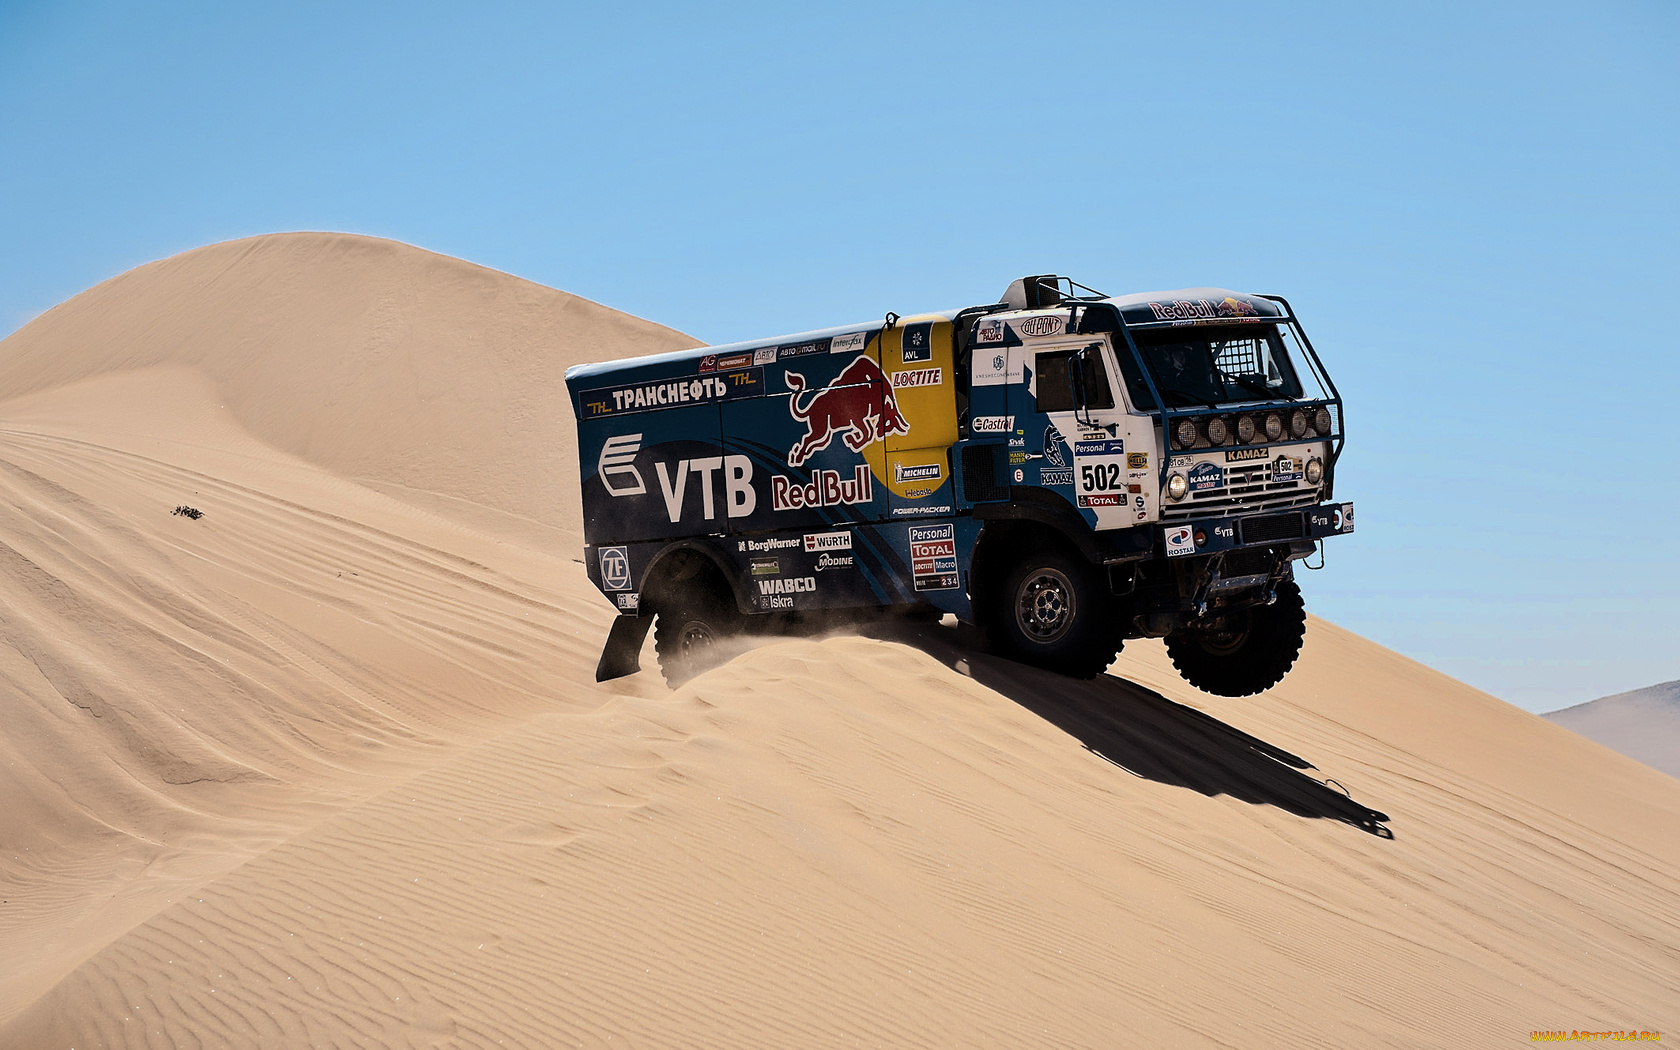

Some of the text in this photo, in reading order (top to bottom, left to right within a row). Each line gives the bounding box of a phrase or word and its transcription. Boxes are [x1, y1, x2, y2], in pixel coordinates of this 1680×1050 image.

[904, 350, 919, 360] AVL
[893, 369, 941, 387] LOCTITE
[612, 376, 727, 411] ТРАНСНЕФТЬ
[982, 418, 1012, 431] Castrol
[1075, 443, 1106, 453] Personal
[1228, 448, 1268, 461] KAMAZ
[903, 467, 939, 478] MICHELIN
[1280, 461, 1292, 472] 502
[1040, 472, 1073, 486] KAMAZ
[1081, 463, 1122, 492] 502
[1190, 473, 1220, 484] KAMAZ
[654, 454, 757, 523] VTB
[1087, 496, 1118, 505] TOTAL
[912, 525, 951, 541] Personal
[1222, 528, 1234, 537] VTB
[747, 538, 801, 552] BorgWarner
[817, 535, 850, 548] WÜRTH
[912, 544, 953, 557] TOTAL
[1168, 547, 1195, 556] ROSTAR
[819, 556, 853, 567] MODINE
[935, 561, 956, 569] Macro
[603, 557, 624, 581] ZF
[758, 576, 816, 596] WABCO
[770, 595, 794, 609] Iskra
